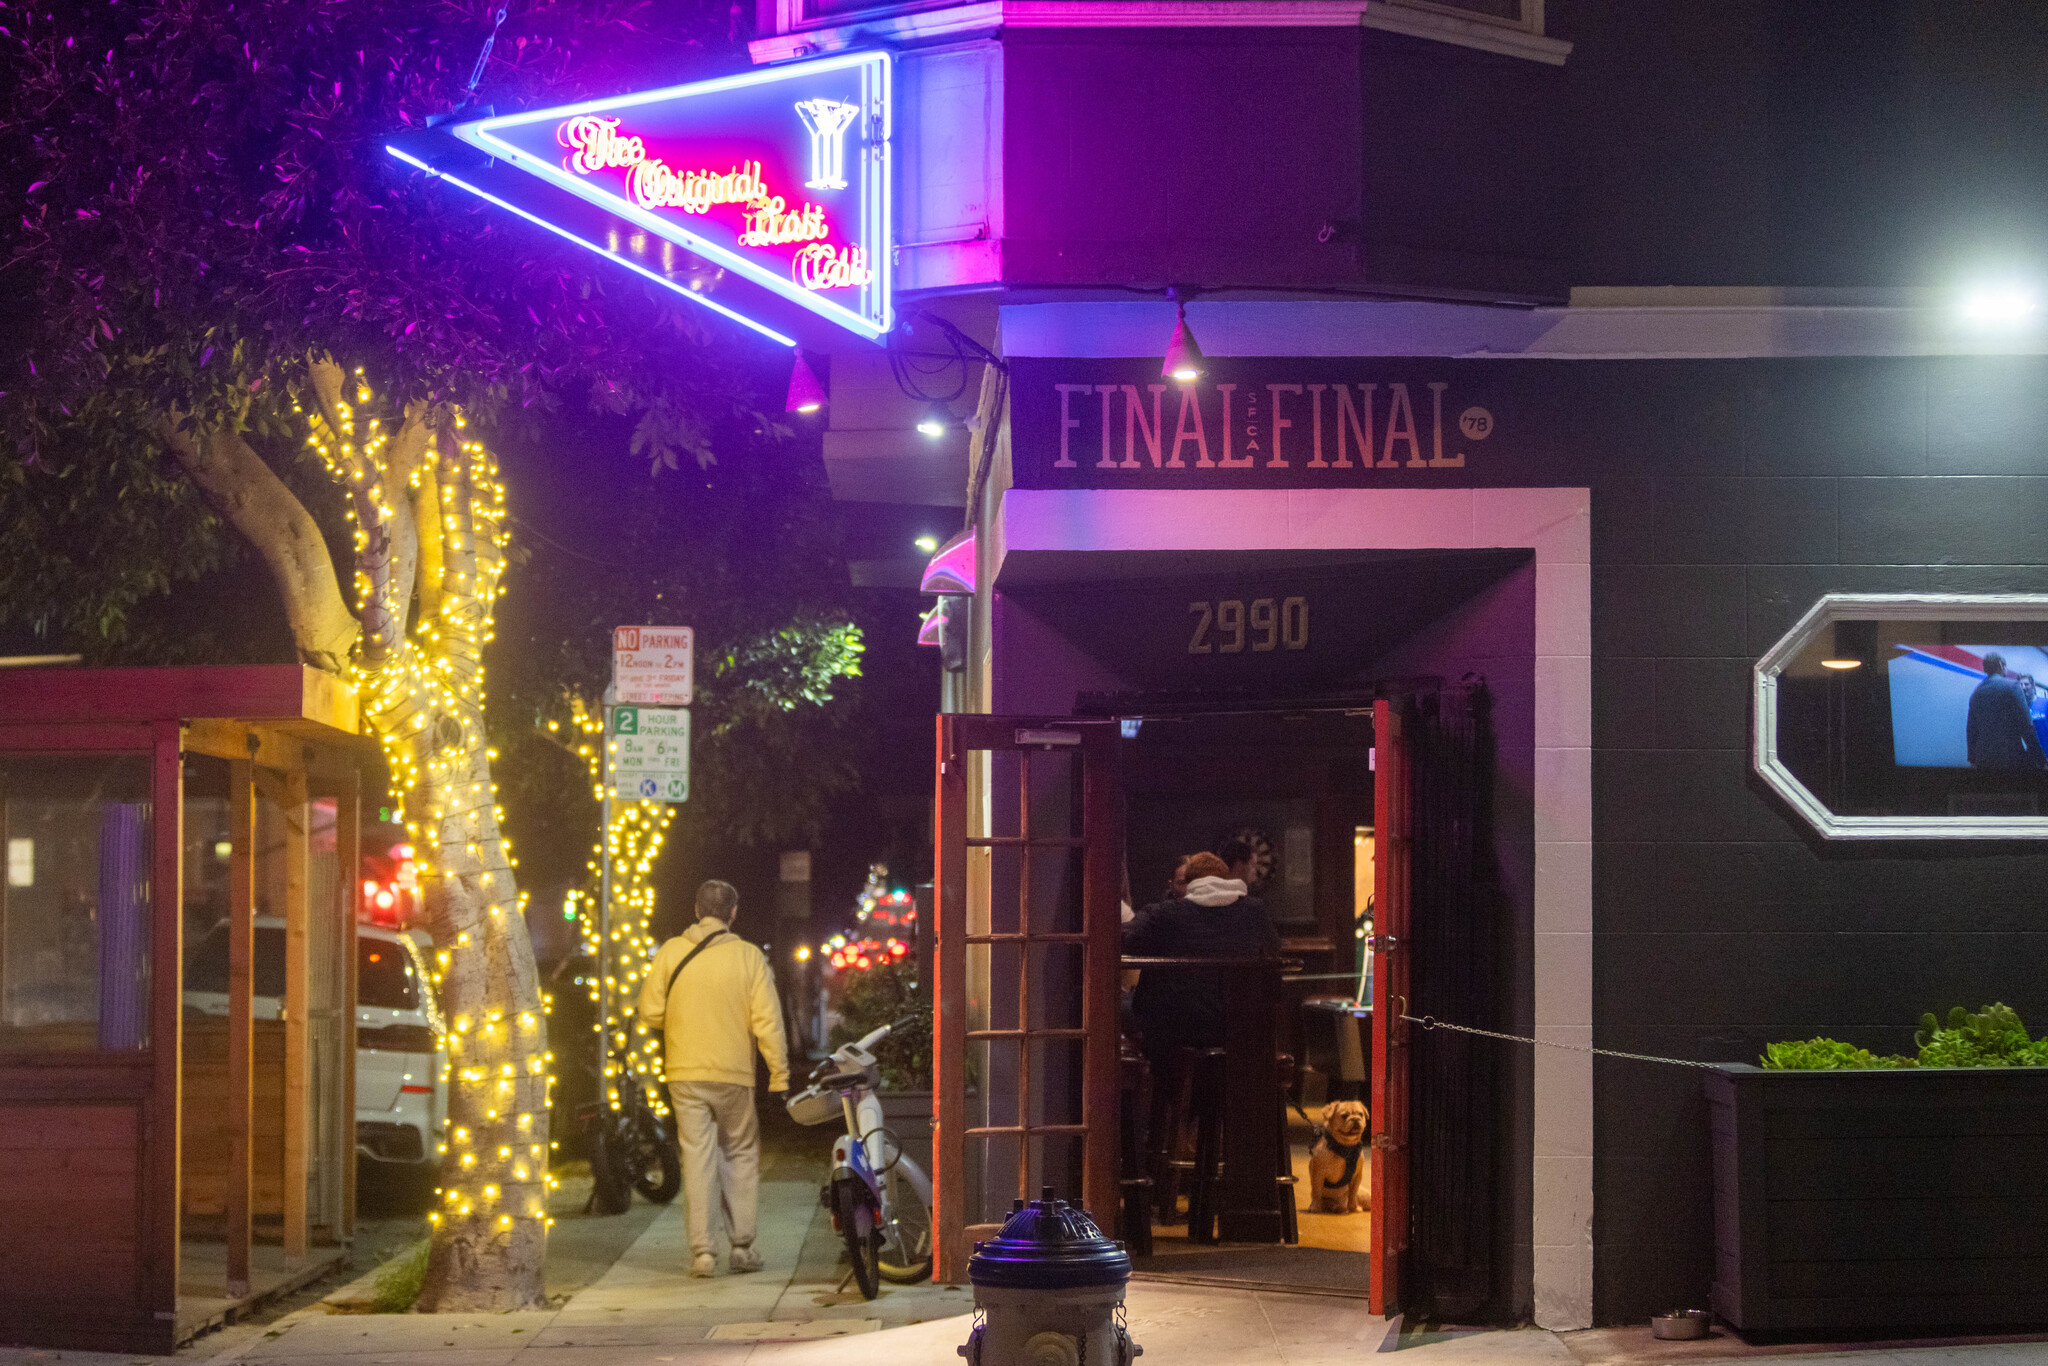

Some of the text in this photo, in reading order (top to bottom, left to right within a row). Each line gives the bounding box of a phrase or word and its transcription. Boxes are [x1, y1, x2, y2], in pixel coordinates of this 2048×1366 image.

[1054, 382, 1466, 469] FINAL FINAL
[1188, 597, 1309, 653] 2990
[617, 629, 688, 649] NO PARKING
[619, 711, 677, 731] 2 HOUR
[639, 725, 685, 737] PARKING
[623, 756, 643, 767] MON
[664, 757, 680, 768] FRI
[669, 780, 683, 797] M
